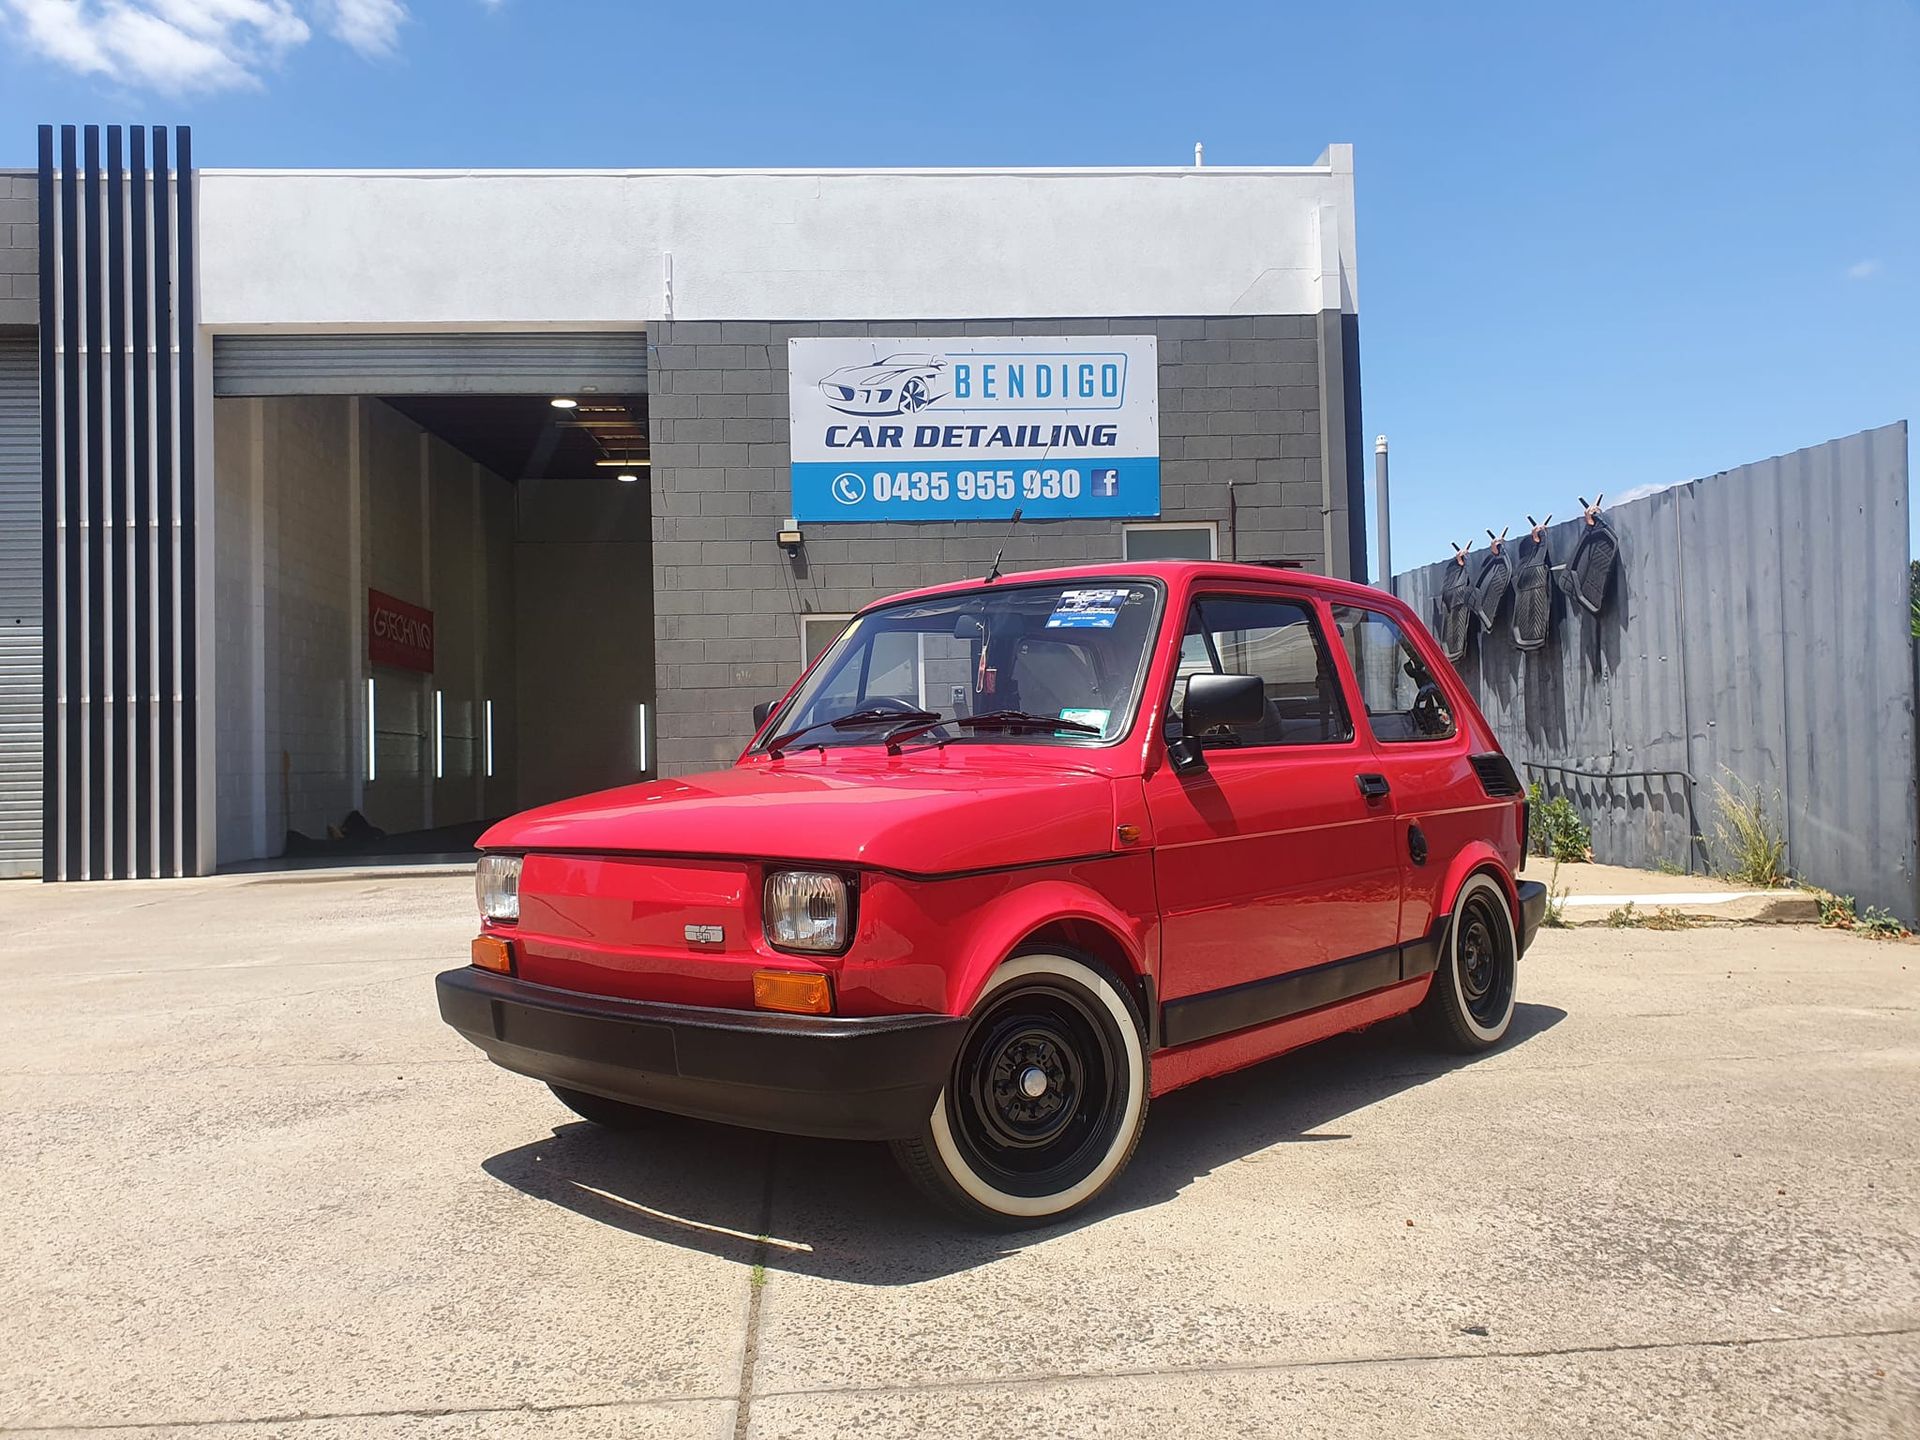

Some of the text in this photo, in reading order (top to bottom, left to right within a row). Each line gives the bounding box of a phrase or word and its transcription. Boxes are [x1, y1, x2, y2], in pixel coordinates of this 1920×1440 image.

[954, 364, 1118, 399] BENDIGO
[824, 424, 1118, 448] CAR DETAILING
[872, 471, 950, 501] 0435
[956, 470, 1015, 500] 955
[1022, 469, 1081, 499] 930
